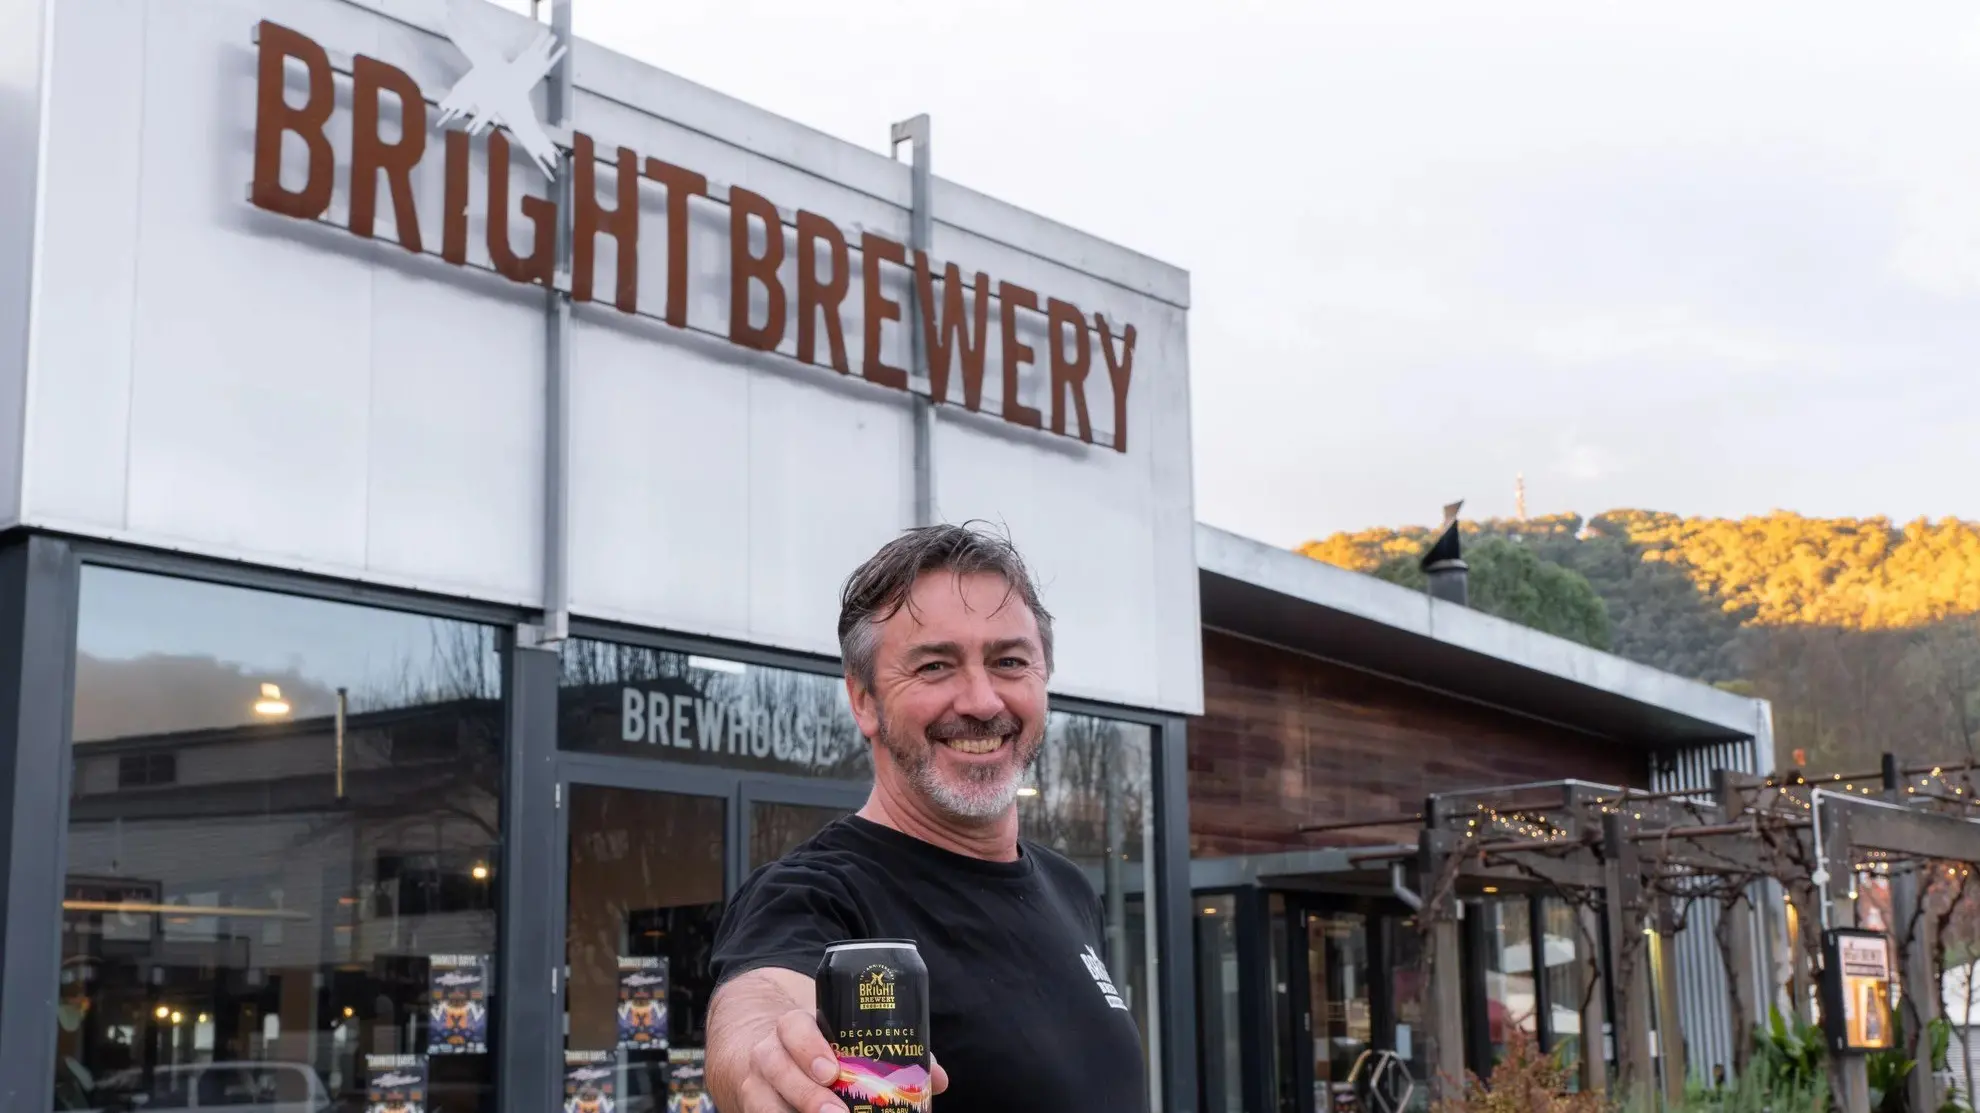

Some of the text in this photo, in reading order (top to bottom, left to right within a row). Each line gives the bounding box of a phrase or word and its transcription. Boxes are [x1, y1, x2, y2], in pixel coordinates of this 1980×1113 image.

[252, 19, 1137, 453] BRIGHT BREWERY
[622, 687, 839, 767] BREWHOUSE
[860, 982, 895, 996] BRIGHT
[840, 1028, 915, 1038] DECADENCE
